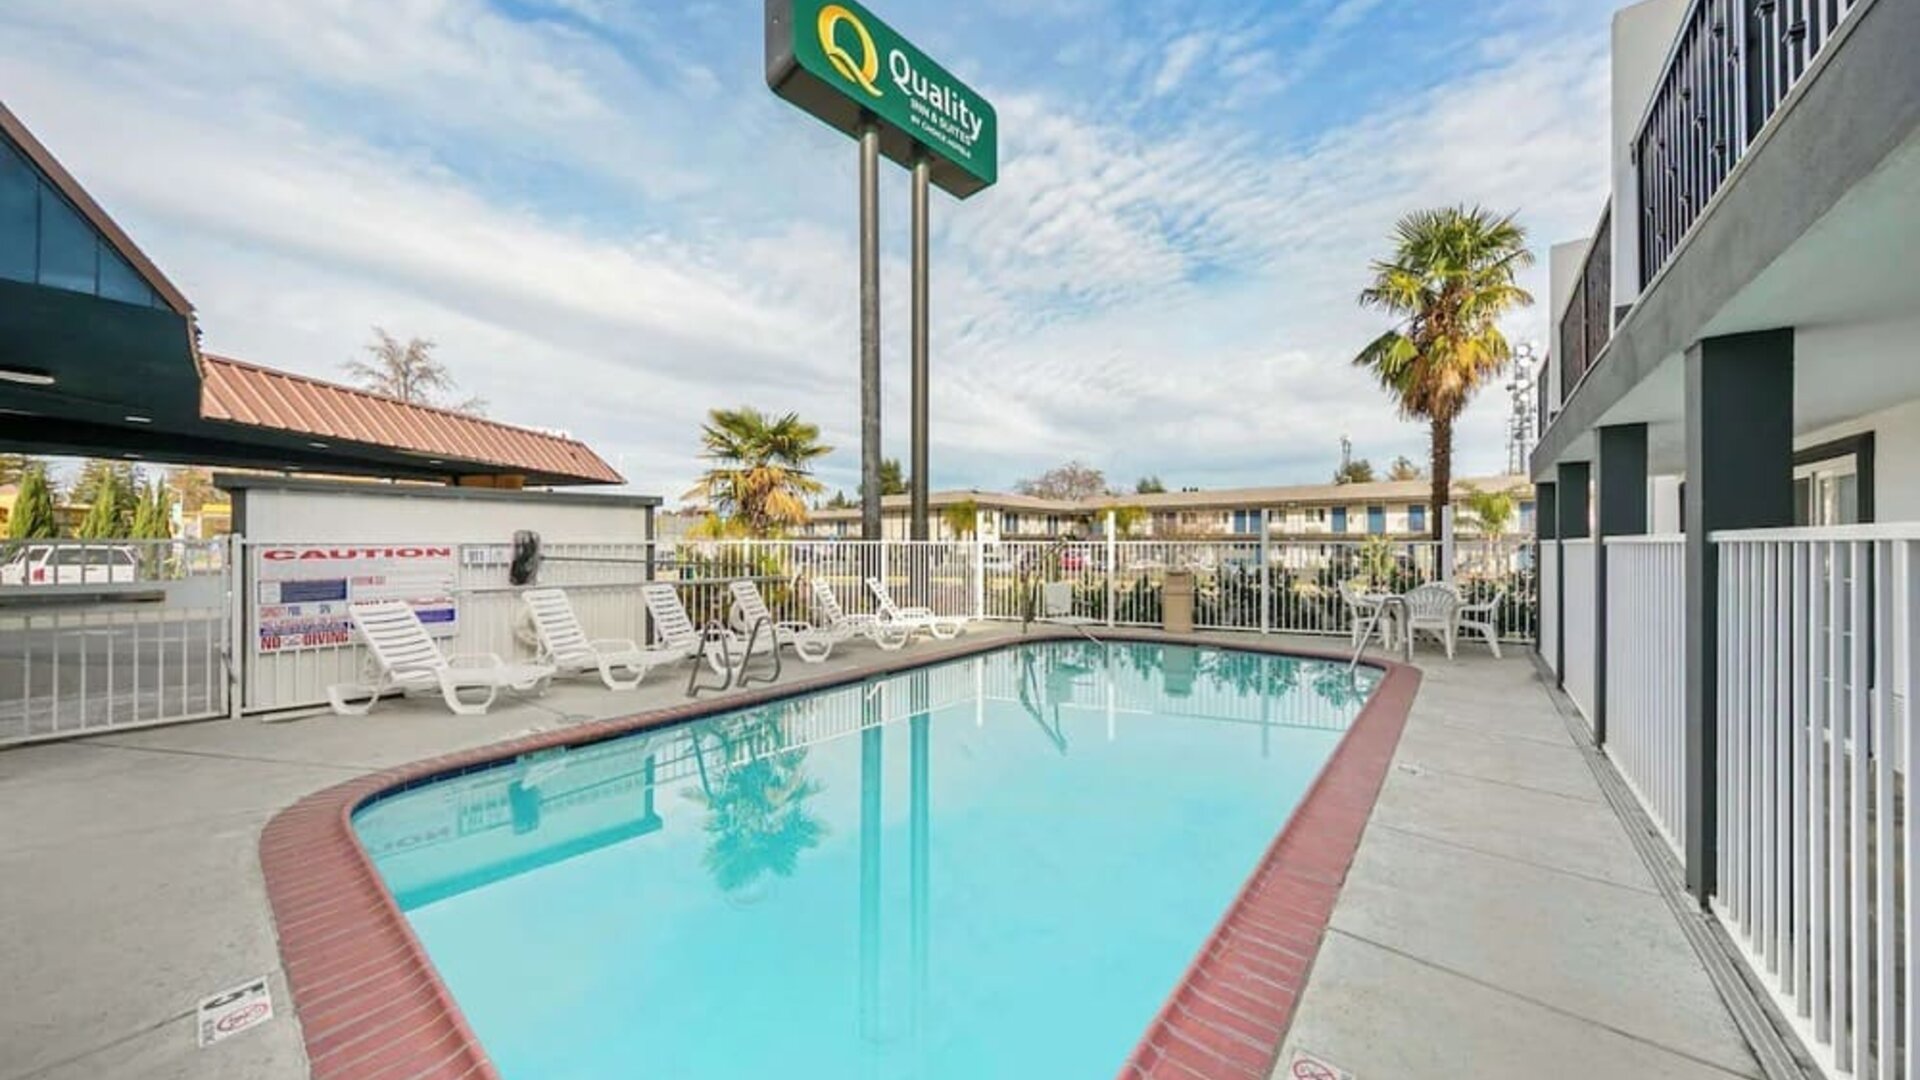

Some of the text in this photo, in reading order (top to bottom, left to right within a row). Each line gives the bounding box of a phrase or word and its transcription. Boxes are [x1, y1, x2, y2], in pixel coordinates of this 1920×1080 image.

[889, 49, 982, 141] Quality
[910, 98, 971, 147] INN & SUITES
[263, 548, 451, 560] CAUTION
[261, 631, 348, 650] NO DIVING
